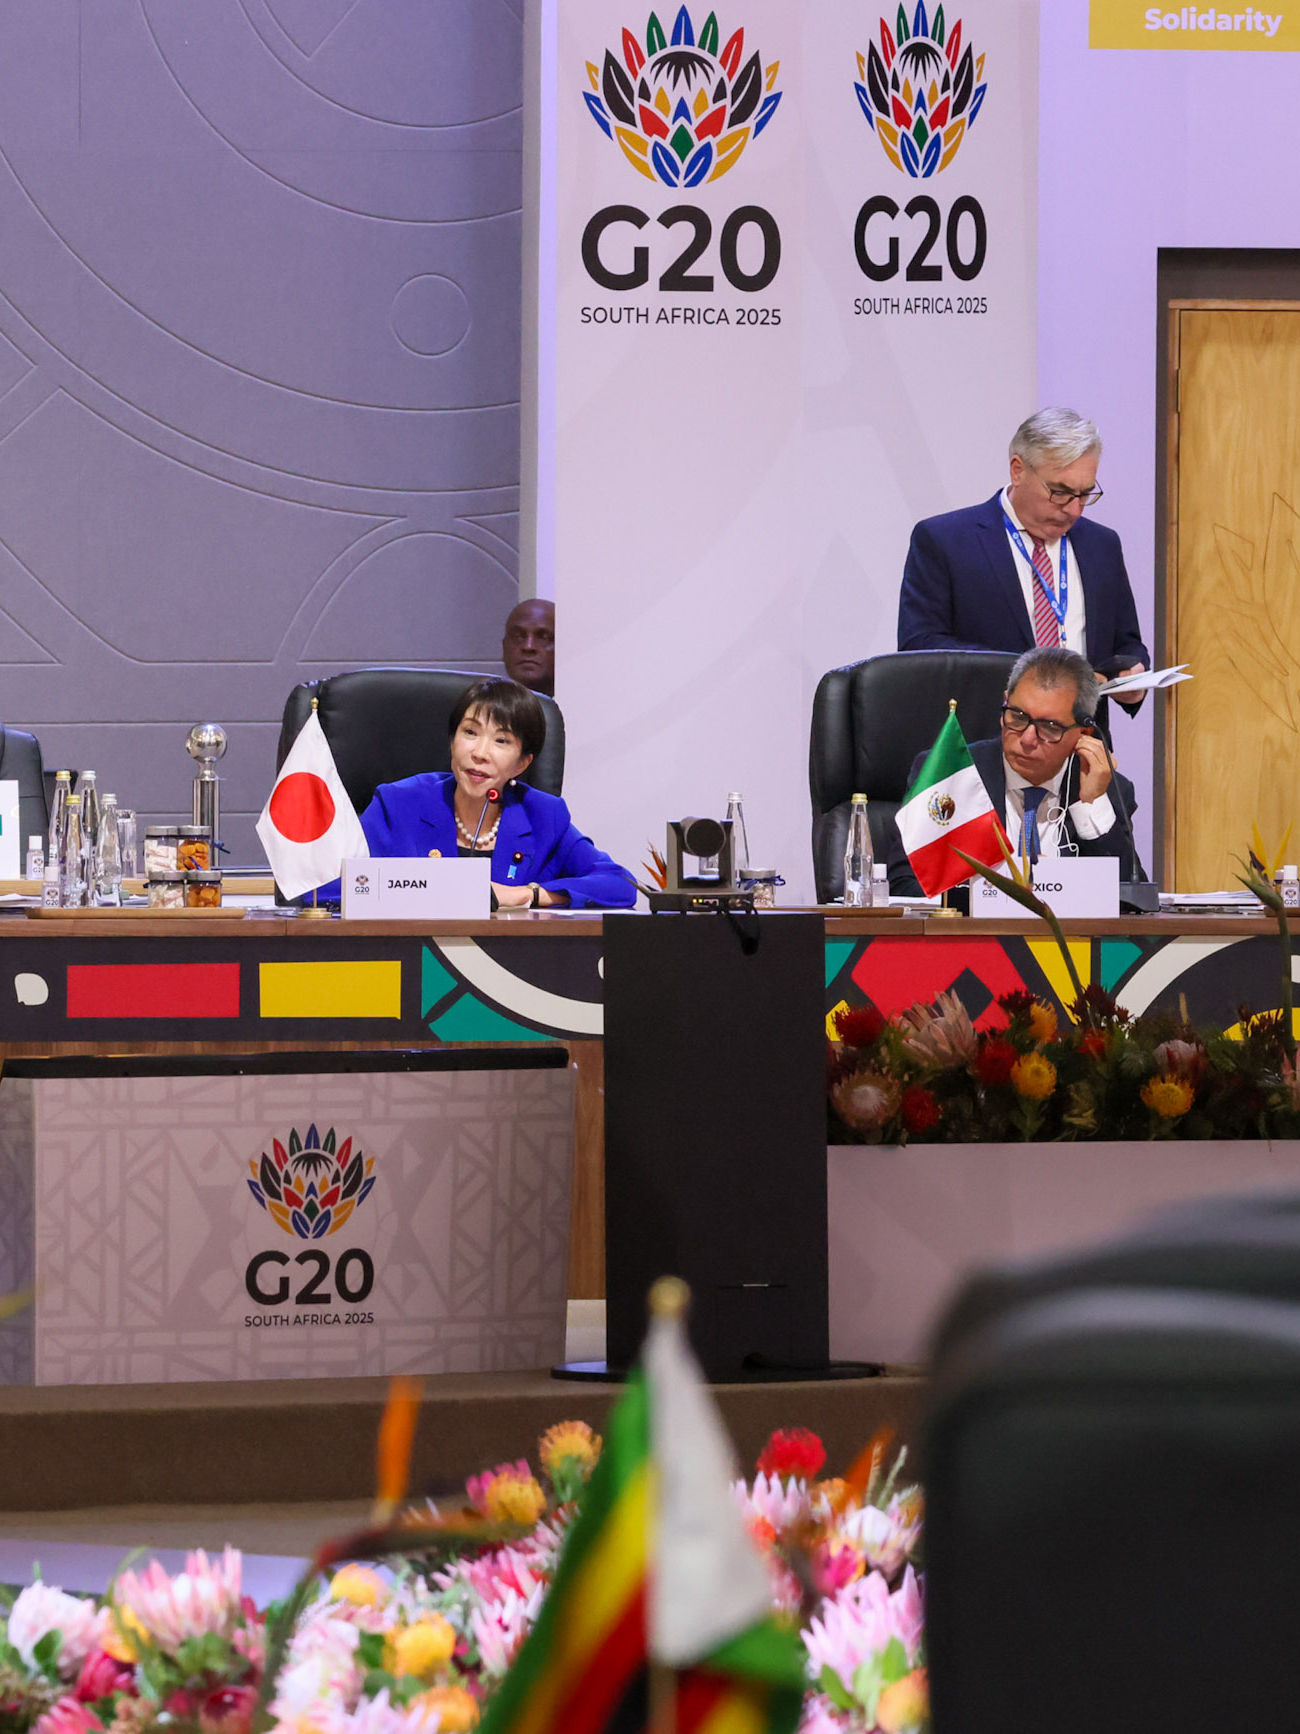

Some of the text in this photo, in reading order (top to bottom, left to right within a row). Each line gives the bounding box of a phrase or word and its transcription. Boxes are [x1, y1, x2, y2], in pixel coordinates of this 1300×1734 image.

[1144, 6, 1283, 37] Solidarity
[581, 204, 781, 292] G20
[854, 195, 987, 282] G20
[854, 296, 988, 315] SOUTH AFRICA 2025
[581, 306, 781, 326] SOUTH AFRICA 2025
[387, 879, 427, 889] JAPAN
[1031, 883, 1063, 892] XICO
[245, 1248, 375, 1306] G20
[244, 1312, 374, 1327] SOUTH AFRICA 2025
